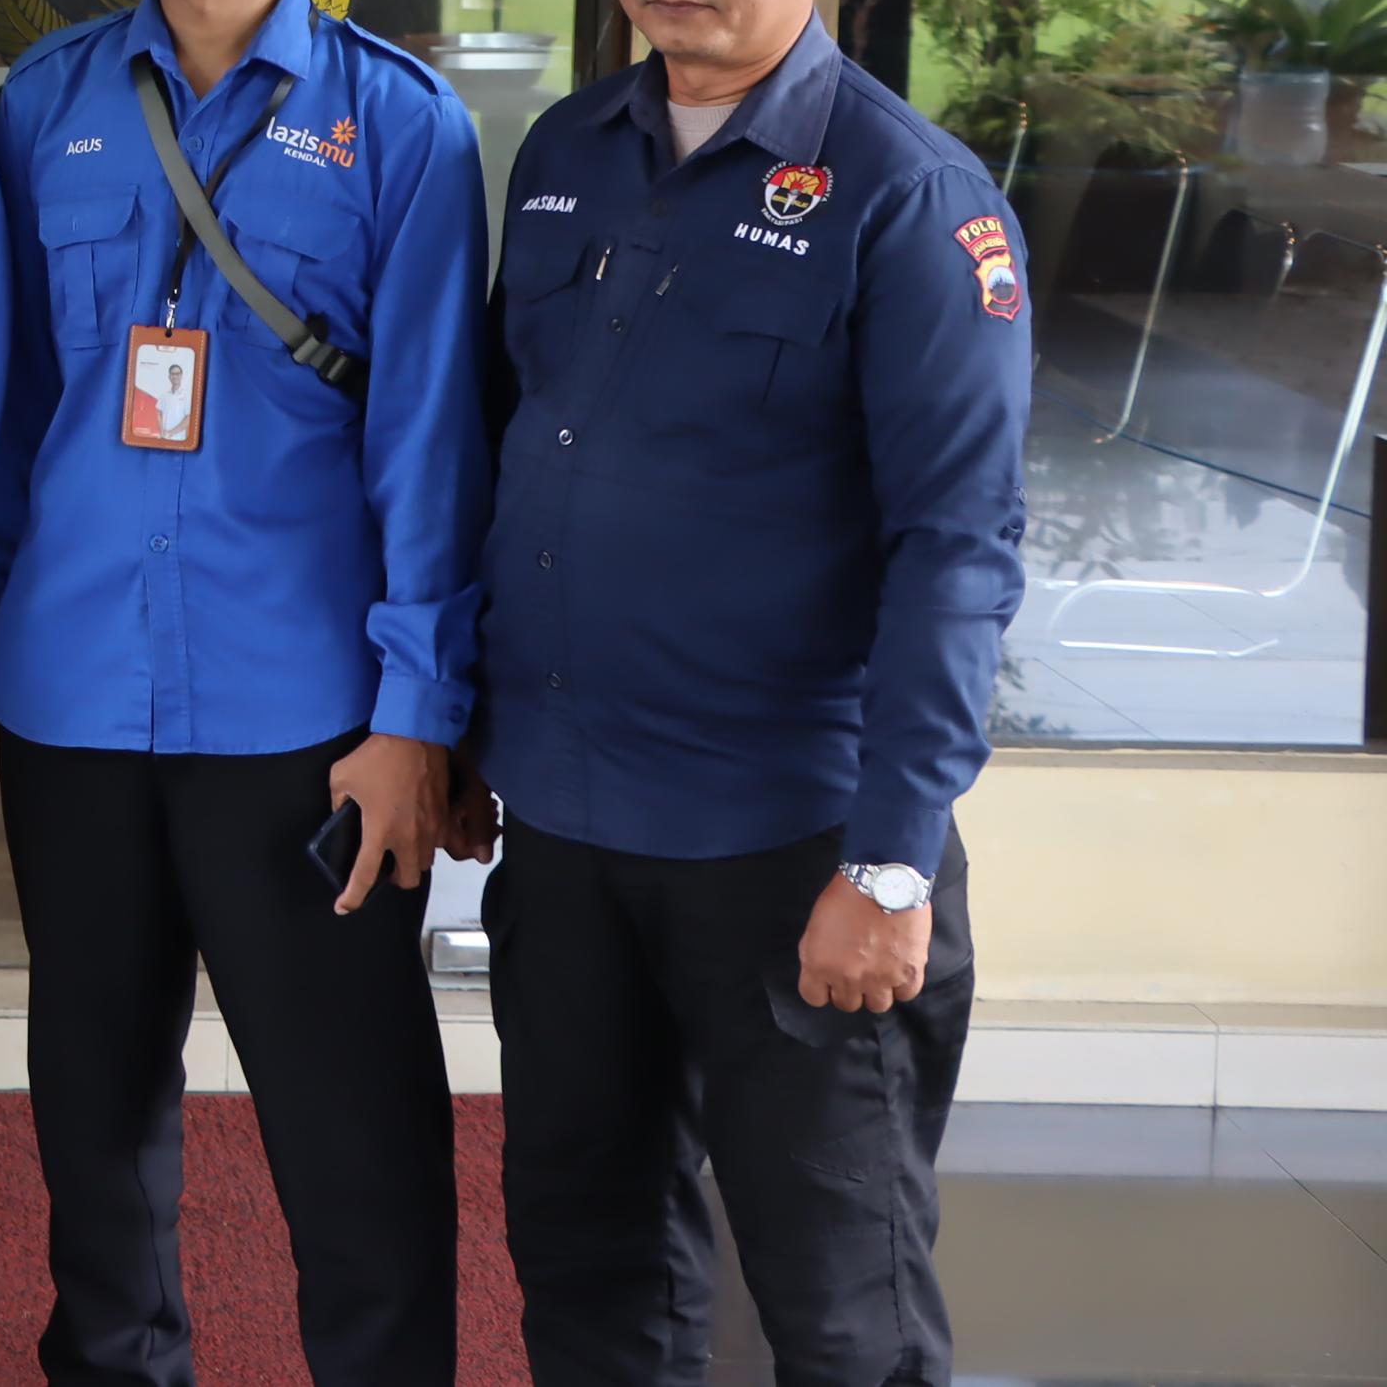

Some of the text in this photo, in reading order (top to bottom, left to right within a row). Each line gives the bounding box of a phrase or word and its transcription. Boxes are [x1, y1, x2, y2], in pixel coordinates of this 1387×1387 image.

[65, 137, 103, 157] AGUS
[265, 116, 355, 168] lazismu
[283, 146, 327, 168] KENDAL
[733, 222, 810, 256] HUMAS
